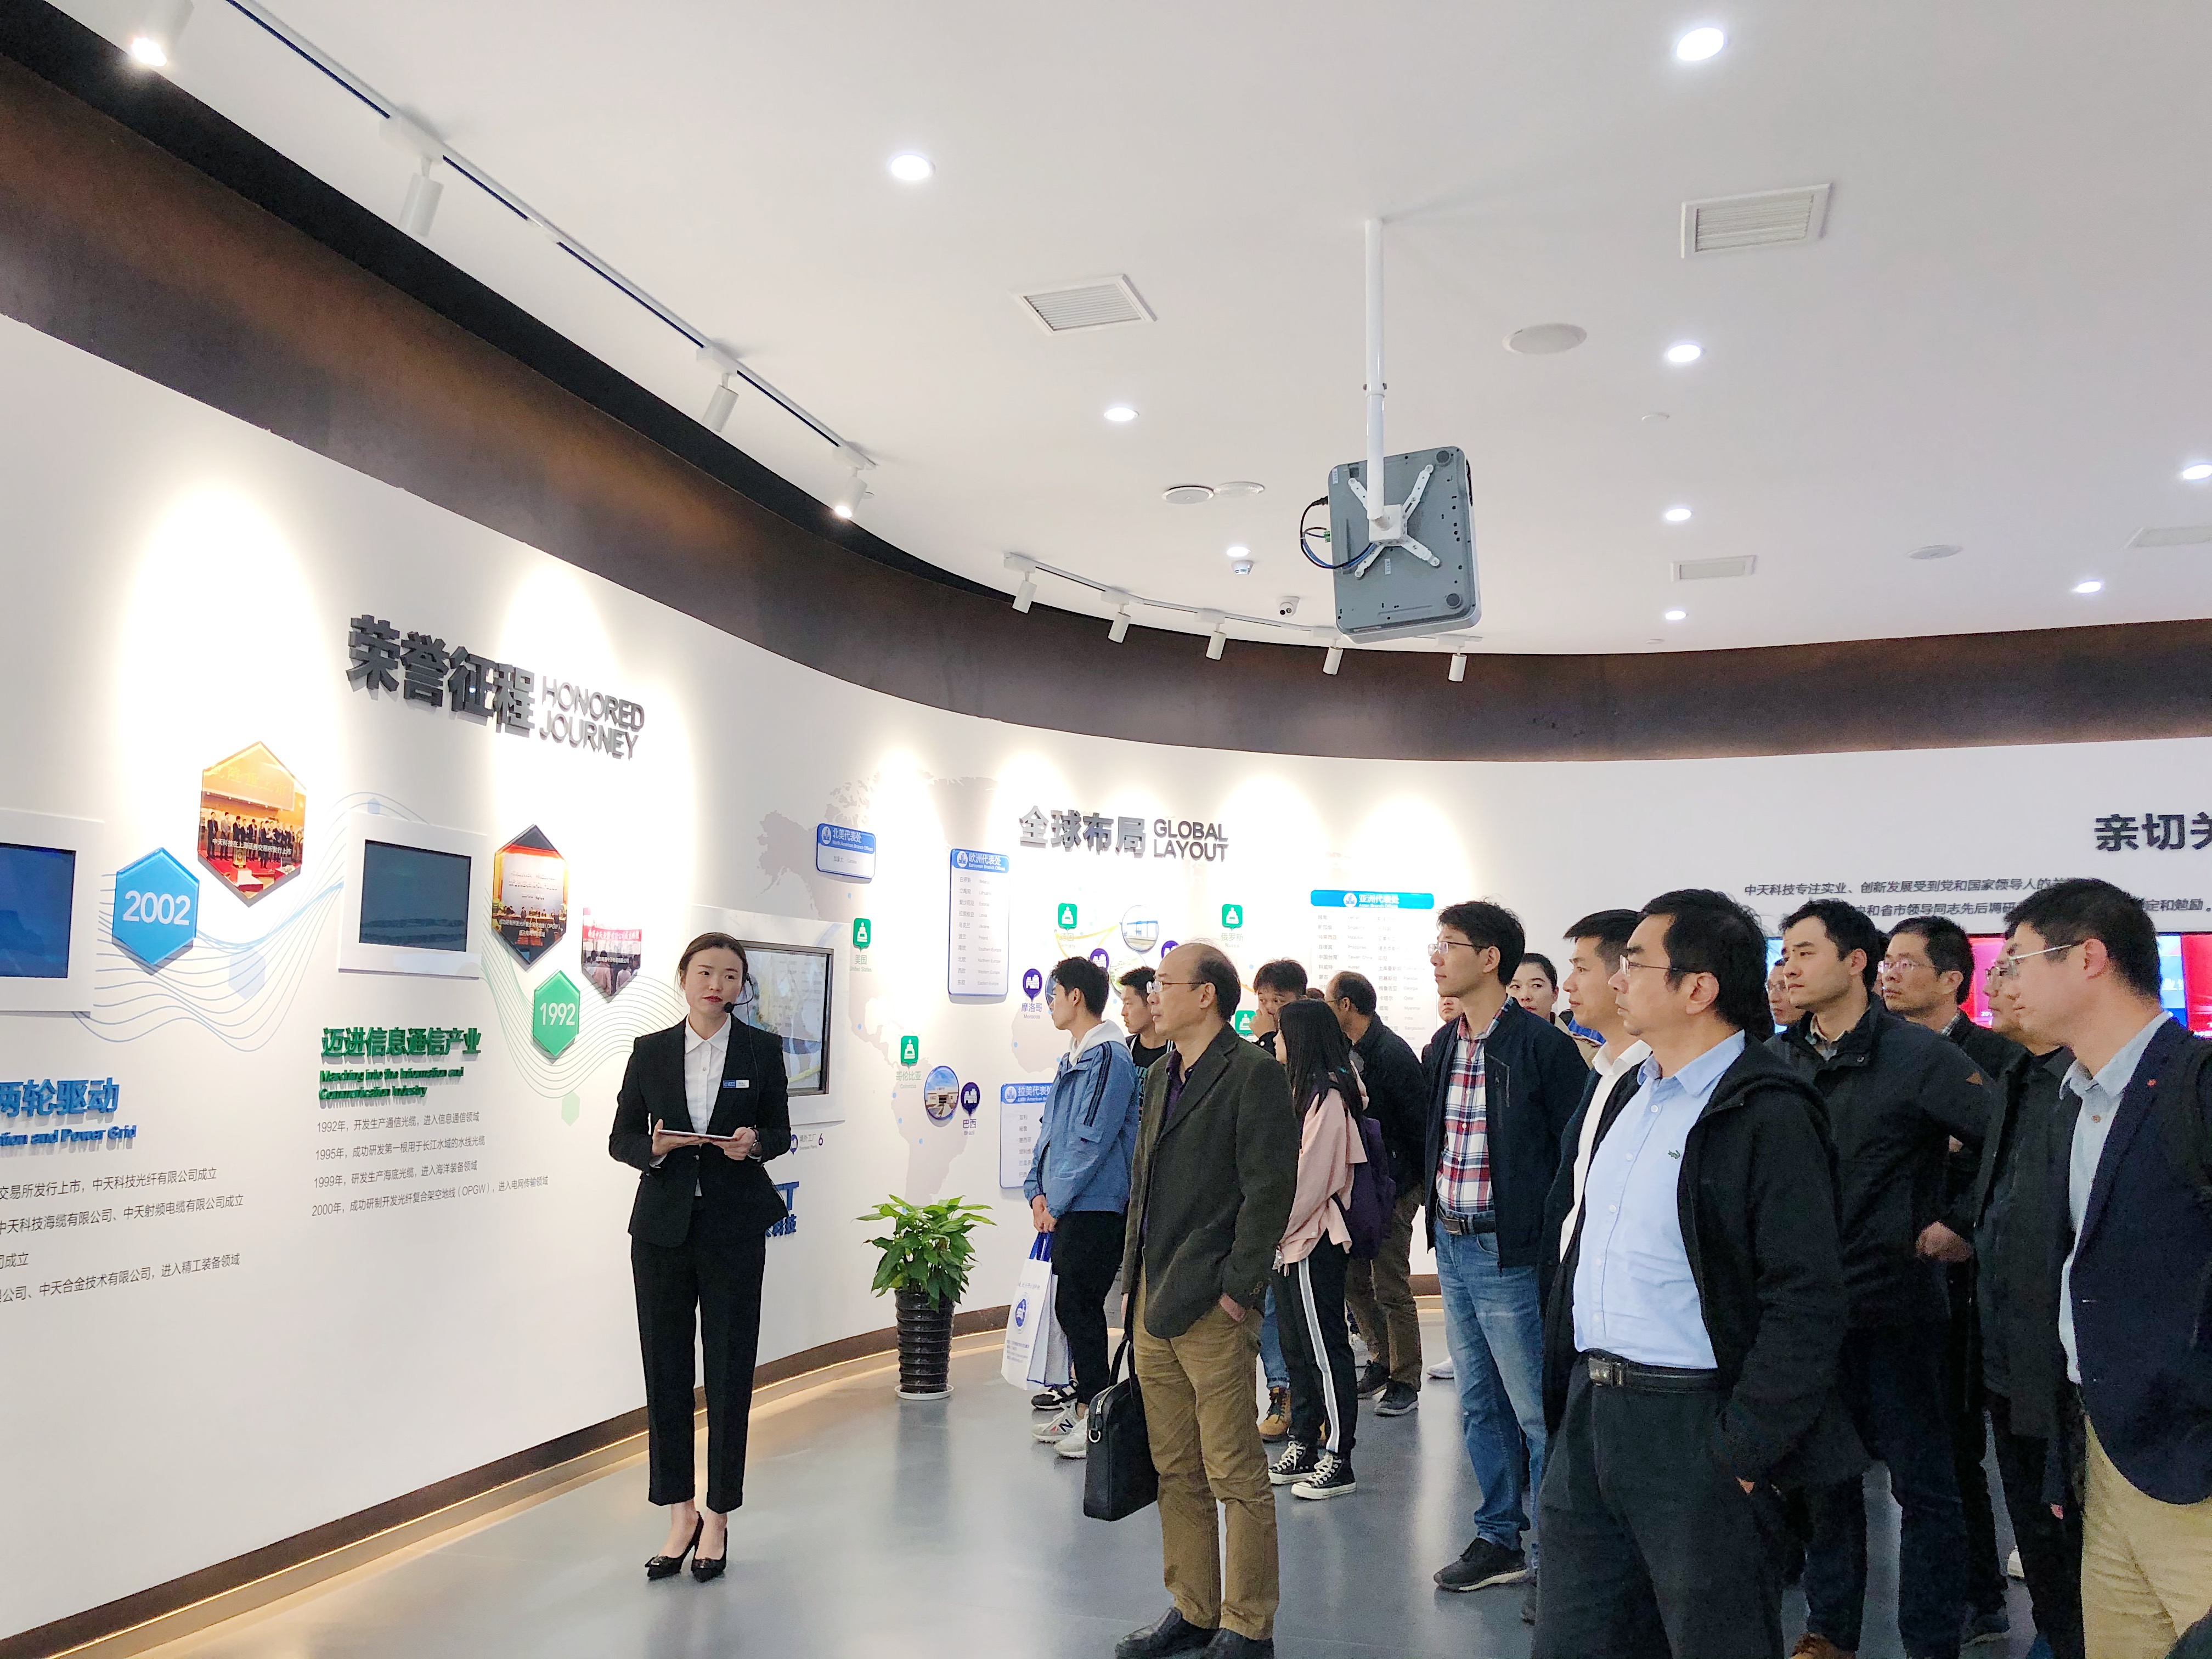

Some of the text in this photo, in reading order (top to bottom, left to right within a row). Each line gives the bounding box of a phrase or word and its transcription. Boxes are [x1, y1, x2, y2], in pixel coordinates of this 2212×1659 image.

[346, 614, 535, 730] 荣誉征程
[543, 675, 645, 730] HONORED
[539, 710, 639, 759] JOURNEY
[832, 827, 862, 843] 北美代表处
[1019, 805, 1146, 856] 全球布局
[1154, 819, 1229, 842] GLOBAL
[968, 853, 1001, 866] 欧洲代表处
[1154, 839, 1229, 862] LAYOUT
[1744, 877, 2064, 896] 中天科技专注实业、创新发展受到党和国家领导人的
[122, 890, 191, 926] 2002
[1221, 933, 1244, 942] 俄罗斯
[854, 955, 867, 966] 美国
[540, 1002, 575, 1026] 1992
[1021, 1003, 1043, 1013] 摩洛哥
[321, 1027, 481, 1057] 迈进信息通信产业
[896, 1071, 922, 1081] 哥伦比亚
[319, 1085, 427, 1101] Communication Industry
[60, 1128, 106, 1142] Power
[107, 1125, 137, 1139] Grid
[963, 1119, 977, 1129] 巴西
[818, 1133, 823, 1146] 6
[0, 1252, 240, 1303] 公司、中天合金技术有限公司，进入精工装备领域
